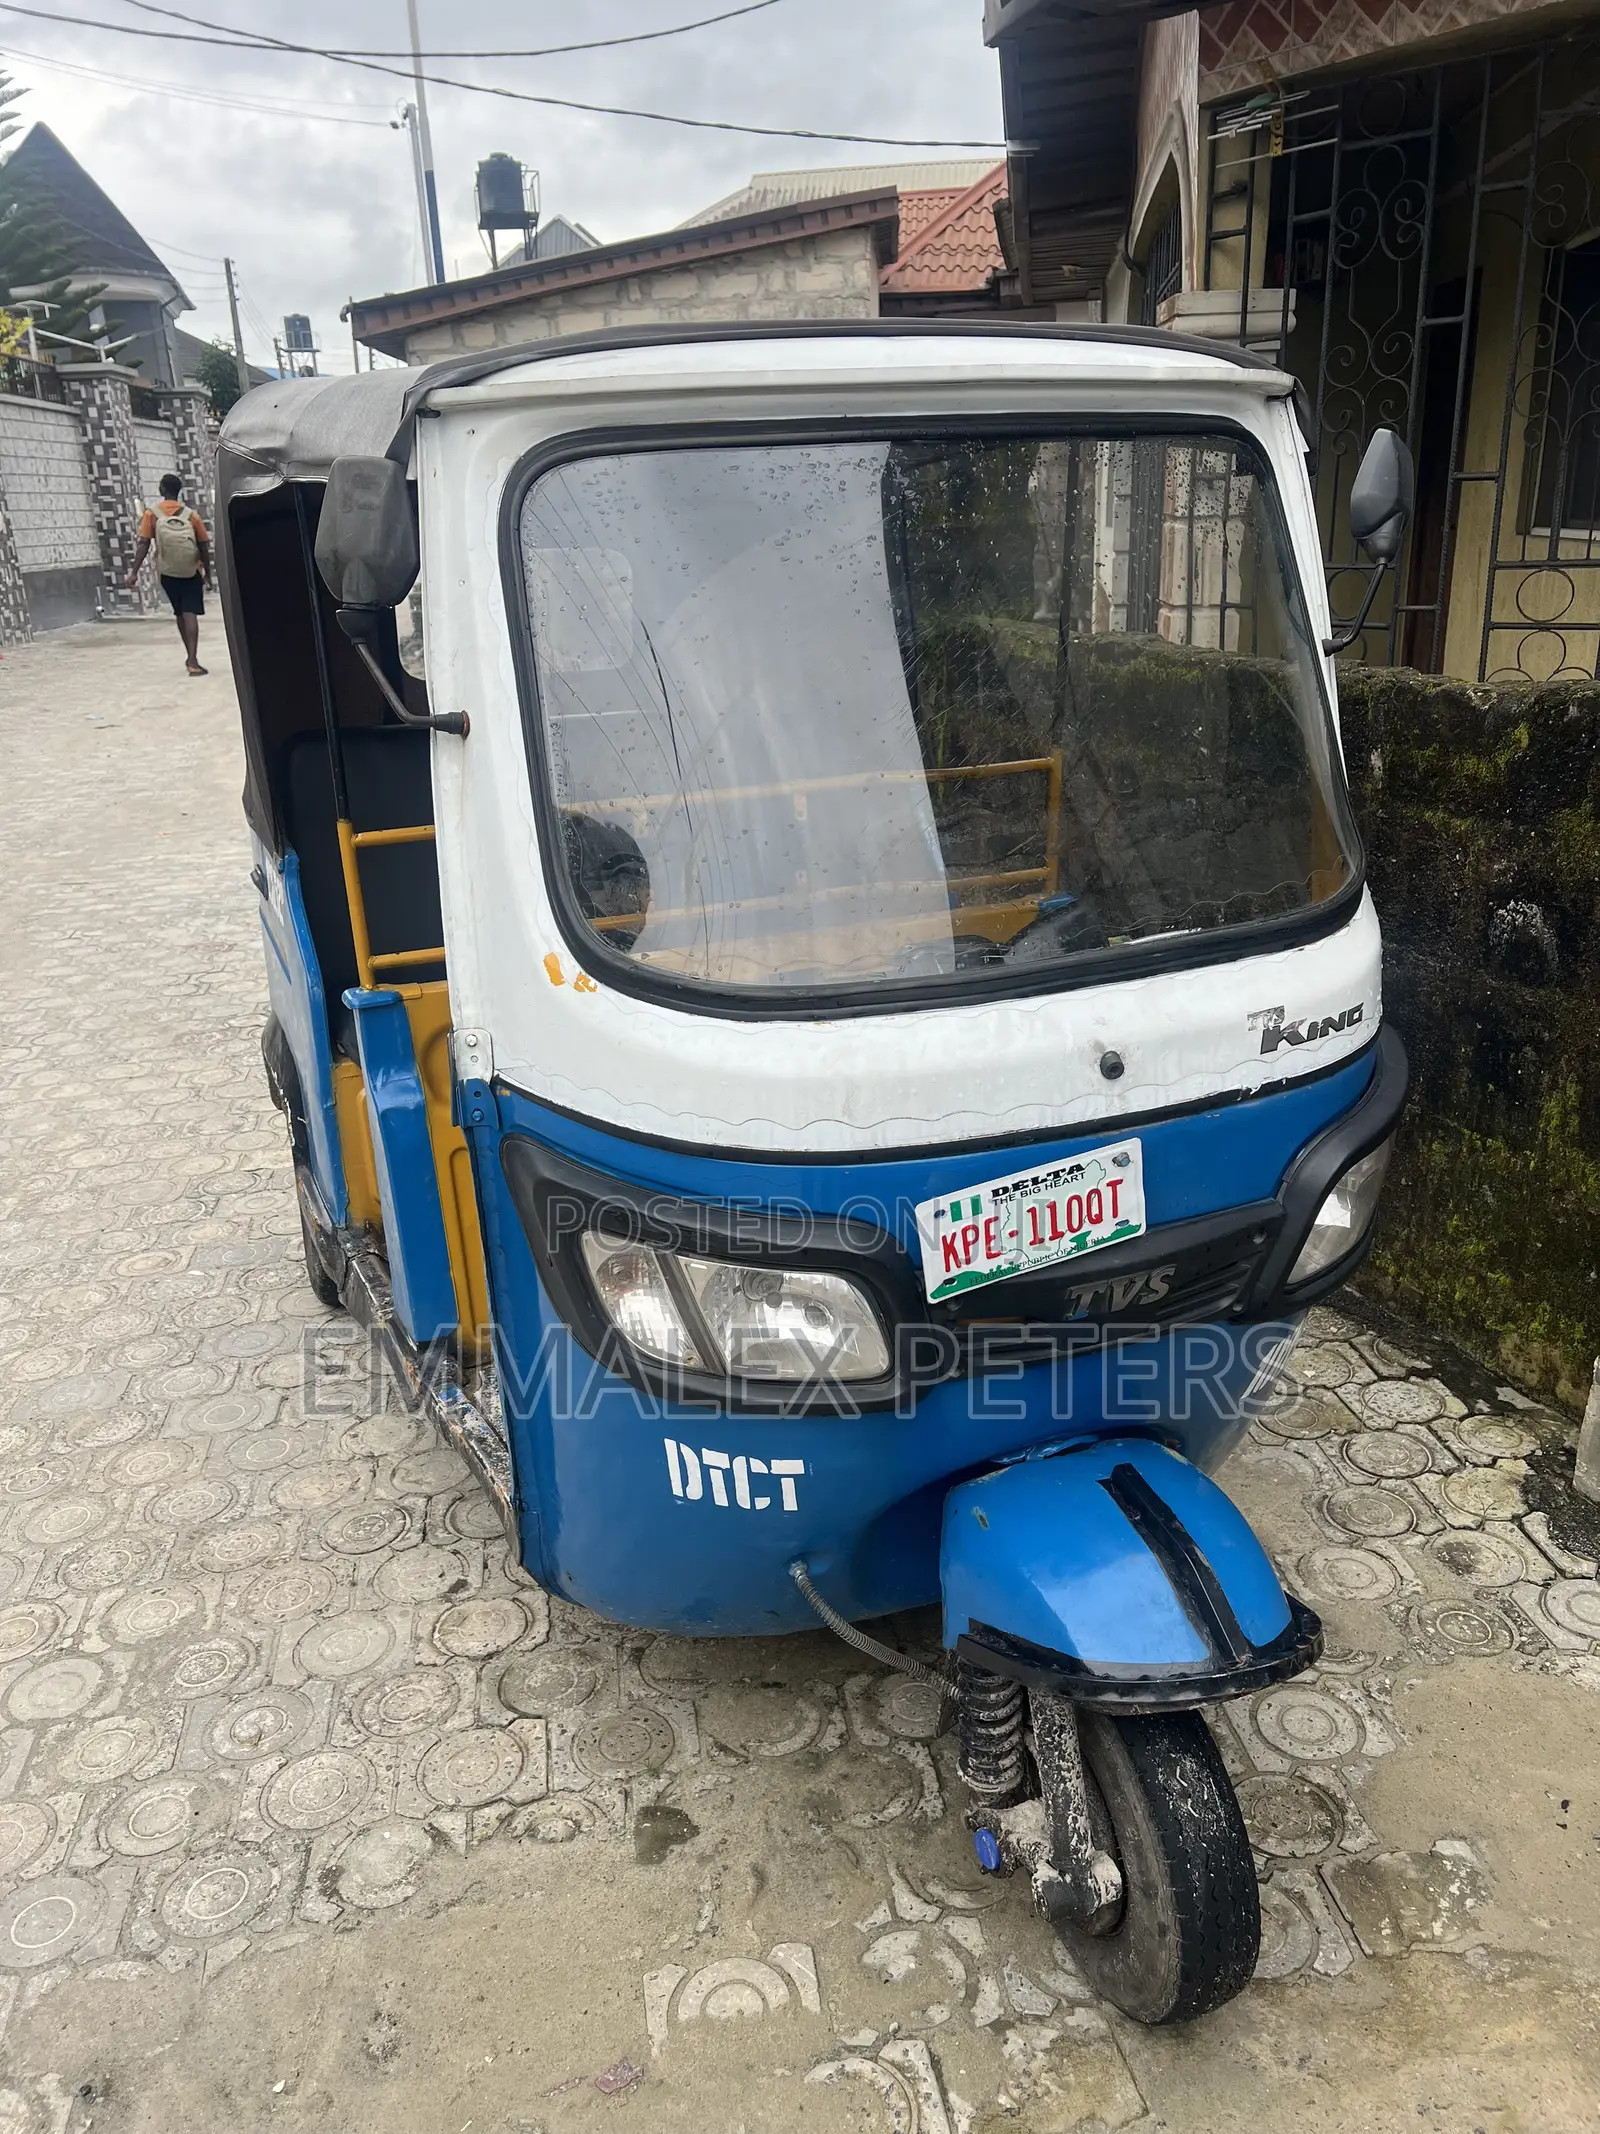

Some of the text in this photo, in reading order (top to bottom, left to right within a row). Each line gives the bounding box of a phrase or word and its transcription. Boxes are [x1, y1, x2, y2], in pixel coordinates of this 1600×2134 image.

[991, 1163, 1085, 1198] DELTA
[992, 1171, 1087, 1206] THE BIG HEART
[941, 1178, 1124, 1273] KPE-110QT
[969, 1267, 1009, 1285] FEDERAL
[1055, 1246, 1069, 1259] OF
[1064, 1263, 1178, 1321] TVS
[664, 1438, 805, 1511] DTCT
